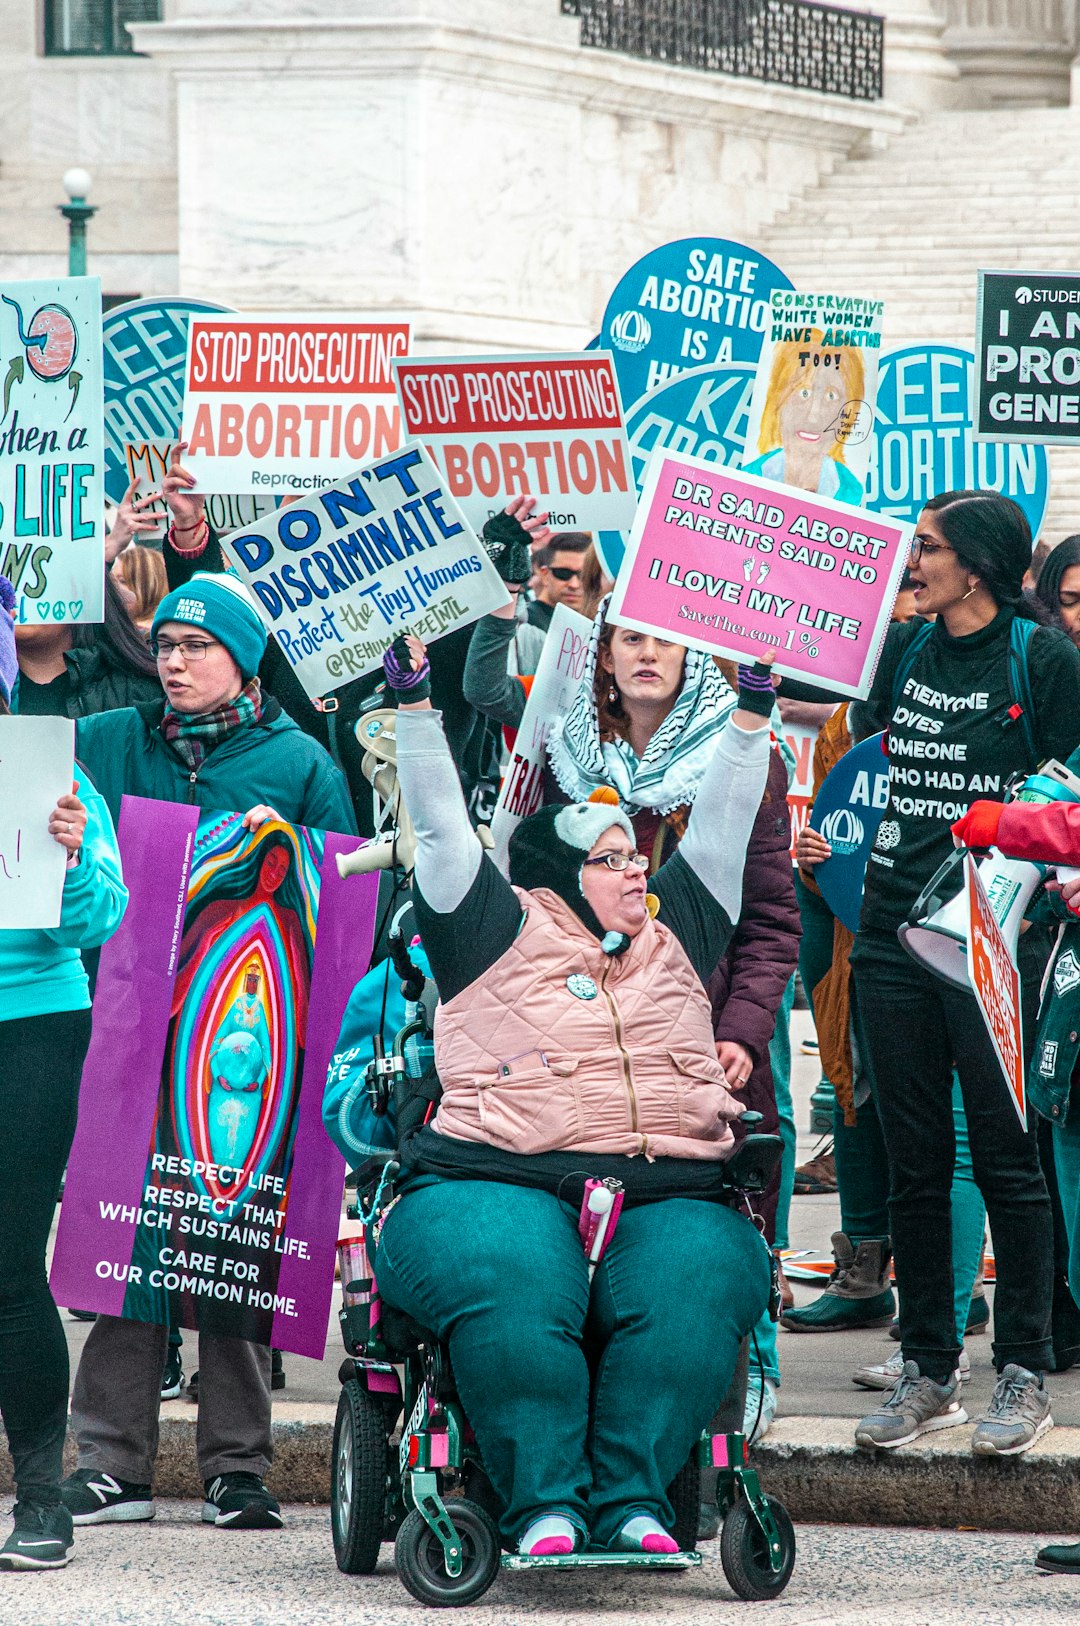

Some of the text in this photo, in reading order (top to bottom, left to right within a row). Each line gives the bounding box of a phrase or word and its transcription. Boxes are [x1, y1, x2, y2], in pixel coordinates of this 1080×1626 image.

[686, 249, 759, 294] SAFE
[638, 276, 768, 333] ABORTIO
[771, 292, 884, 315] CONSERVATIVE
[772, 309, 873, 328] WHITE WOMEN
[999, 309, 1009, 337] I
[680, 327, 708, 360] IS
[716, 336, 733, 363] A
[771, 324, 812, 343] HAVE
[194, 331, 406, 386] STOP PROSECUTING
[799, 352, 841, 370] TOO!
[403, 373, 460, 425] STOP
[463, 367, 618, 423] PROSECUTING
[988, 392, 1079, 423] GENE
[67, 428, 89, 451] a
[187, 402, 400, 460] ABORTION
[126, 444, 171, 482] MY
[251, 470, 338, 489] Reproactio
[14, 463, 95, 541] LIFE
[231, 449, 423, 573] DON'T
[672, 477, 887, 560] DR SAID ABORT
[251, 487, 466, 622] DISCRIMINATE
[664, 505, 878, 585] PARENTS SAID NO
[0, 541, 53, 599] NS
[275, 553, 483, 666] Protect the Tiny Humans
[648, 558, 862, 641] I LOVE MY LIFE
[888, 734, 967, 761] OMEONE
[924, 770, 965, 791] HAD
[967, 774, 1000, 793] AN
[151, 1153, 287, 1196] RESPECT LIFE.
[144, 1185, 286, 1228] RESPECT THAT
[99, 1201, 311, 1260] WHICH SUSTAINS LIFE.
[159, 1247, 260, 1283] CARE FOR
[95, 1260, 298, 1317] OUR COMMON HOME.
